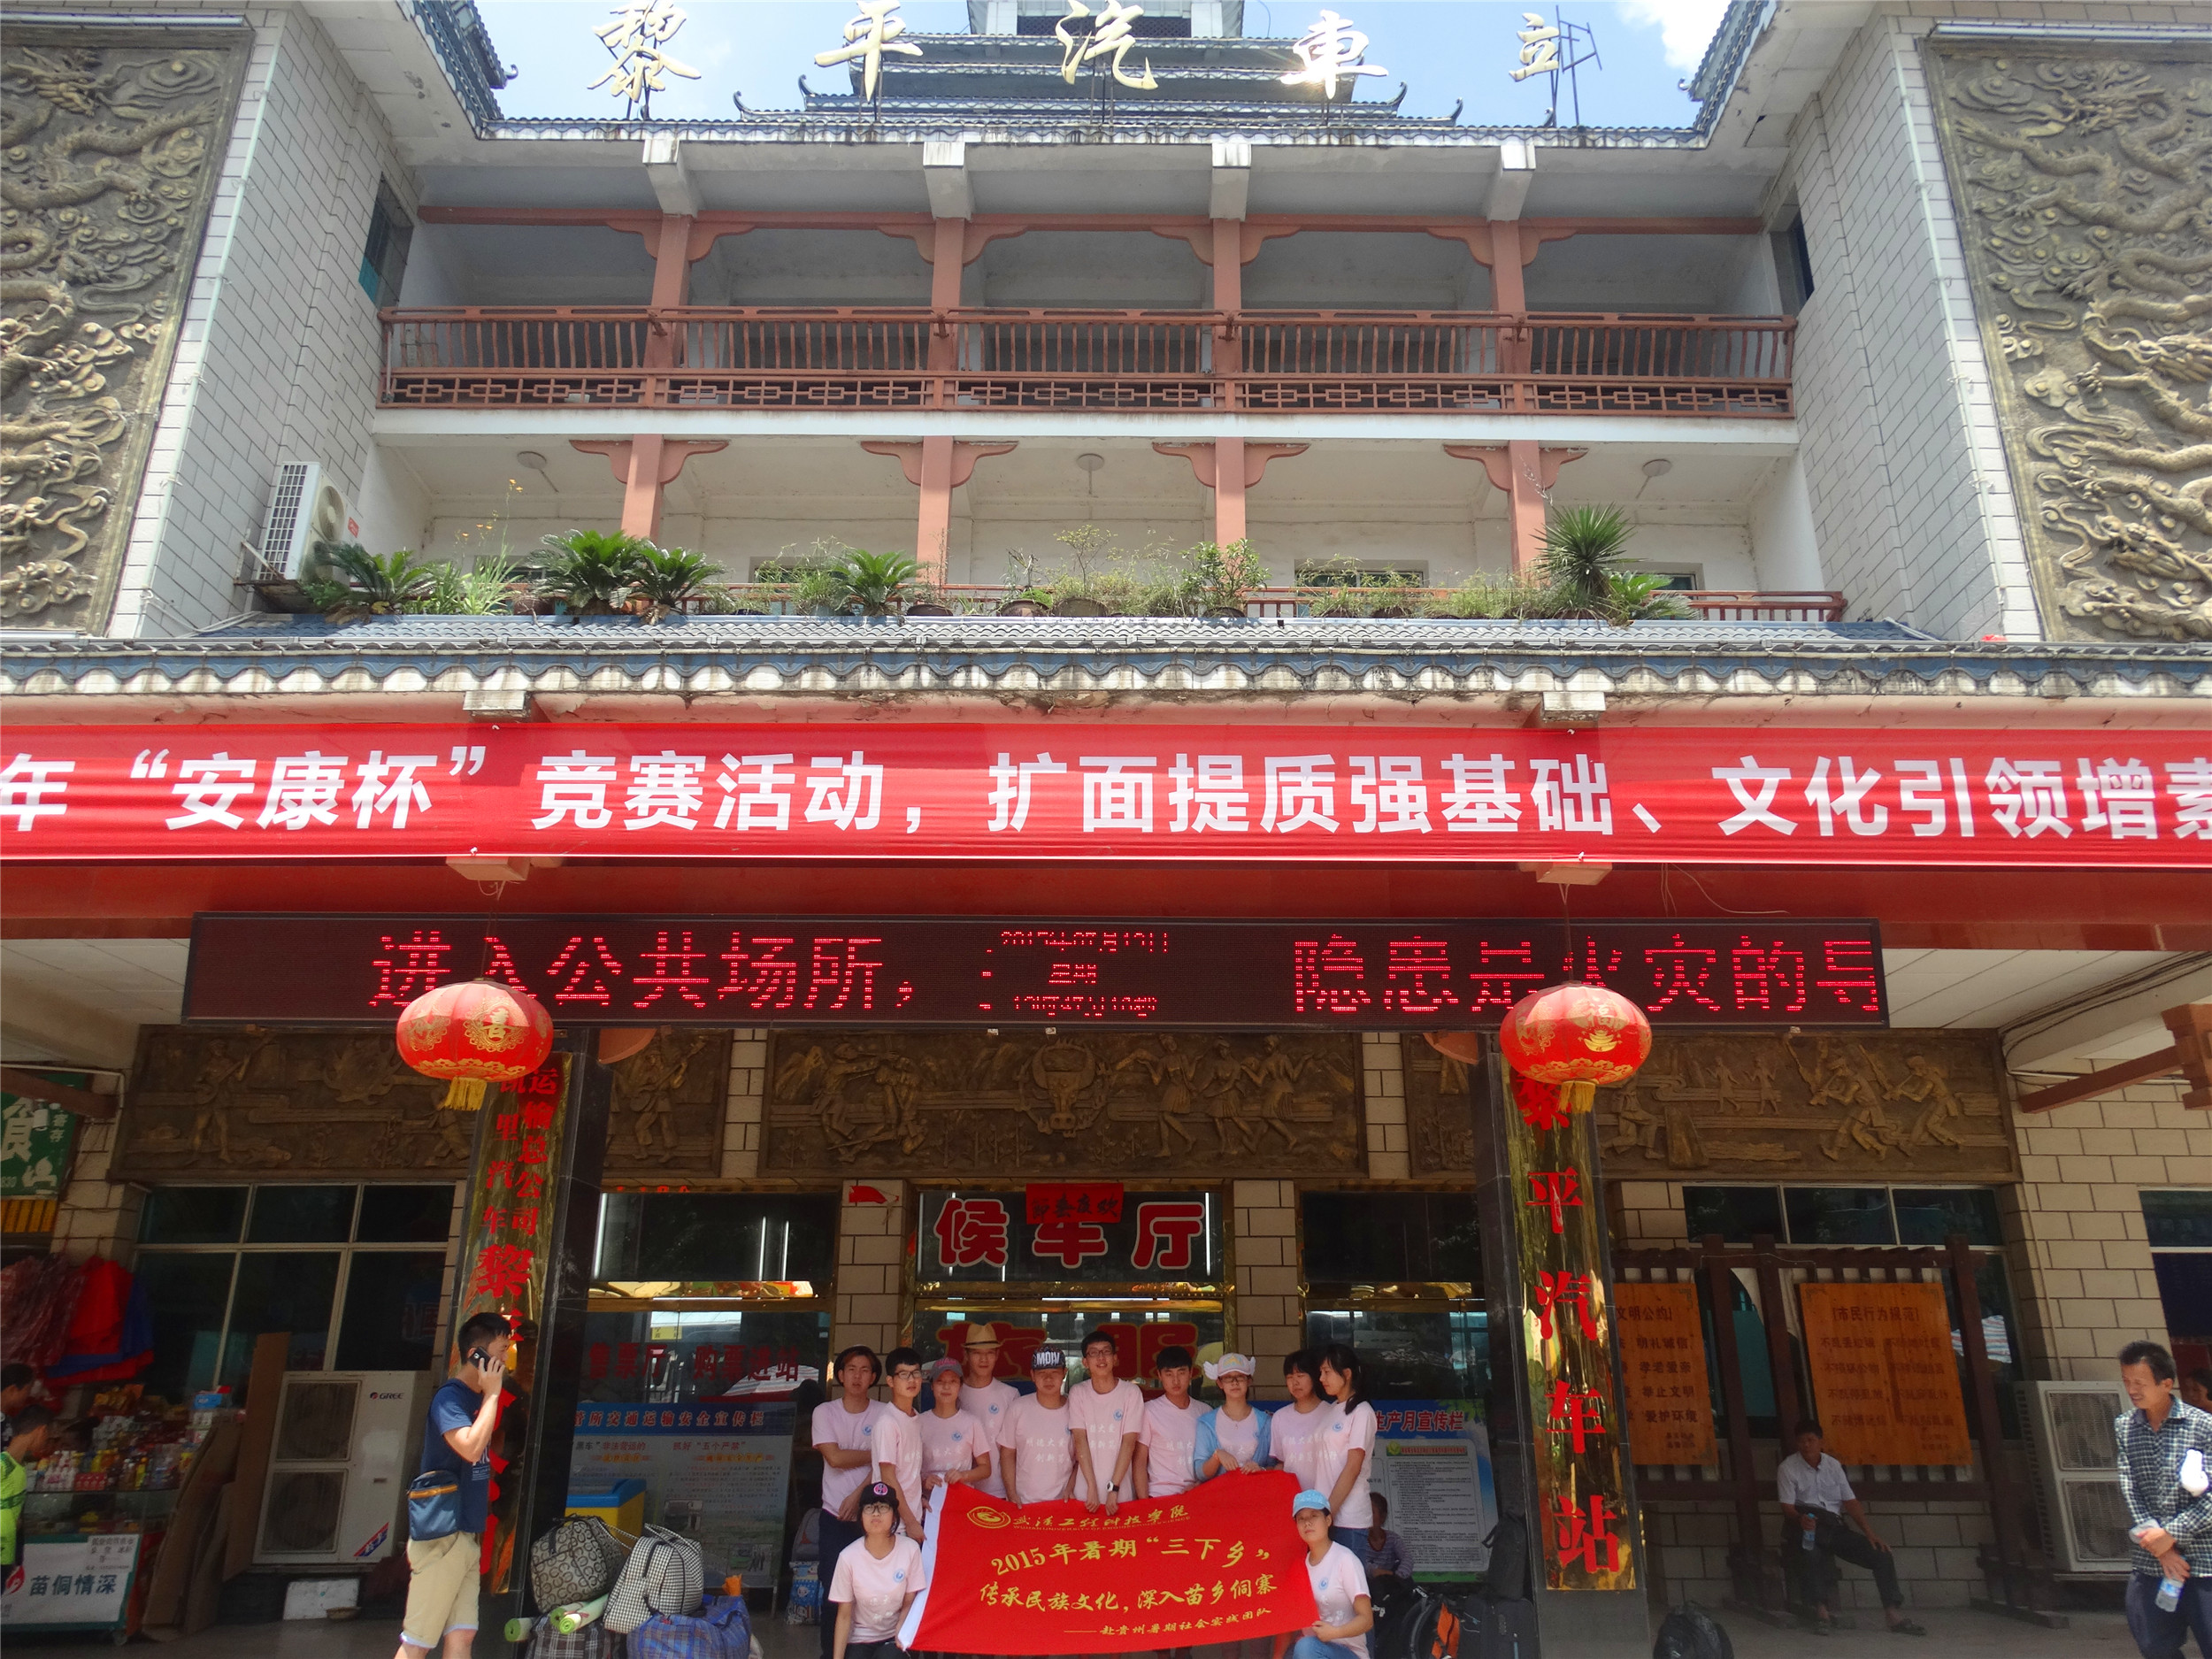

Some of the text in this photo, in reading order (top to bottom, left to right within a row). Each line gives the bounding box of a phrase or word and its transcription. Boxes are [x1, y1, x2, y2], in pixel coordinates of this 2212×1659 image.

[511, 1067, 560, 1236] 运输总公司
[934, 1197, 1205, 1271] 候车厅
[1515, 1072, 1620, 1575] 黎平汽车站
[588, 1341, 669, 1381] 售票厅
[1642, 1386, 1695, 1398] 举止文明
[1646, 1409, 1698, 1424] 爱护环境
[991, 1536, 1270, 1576] 2015年暑期“三下乡”
[30, 1573, 119, 1596] 苗侗情深
[979, 1572, 1279, 1614] 传承民族文化，深入苗乡侗寨
